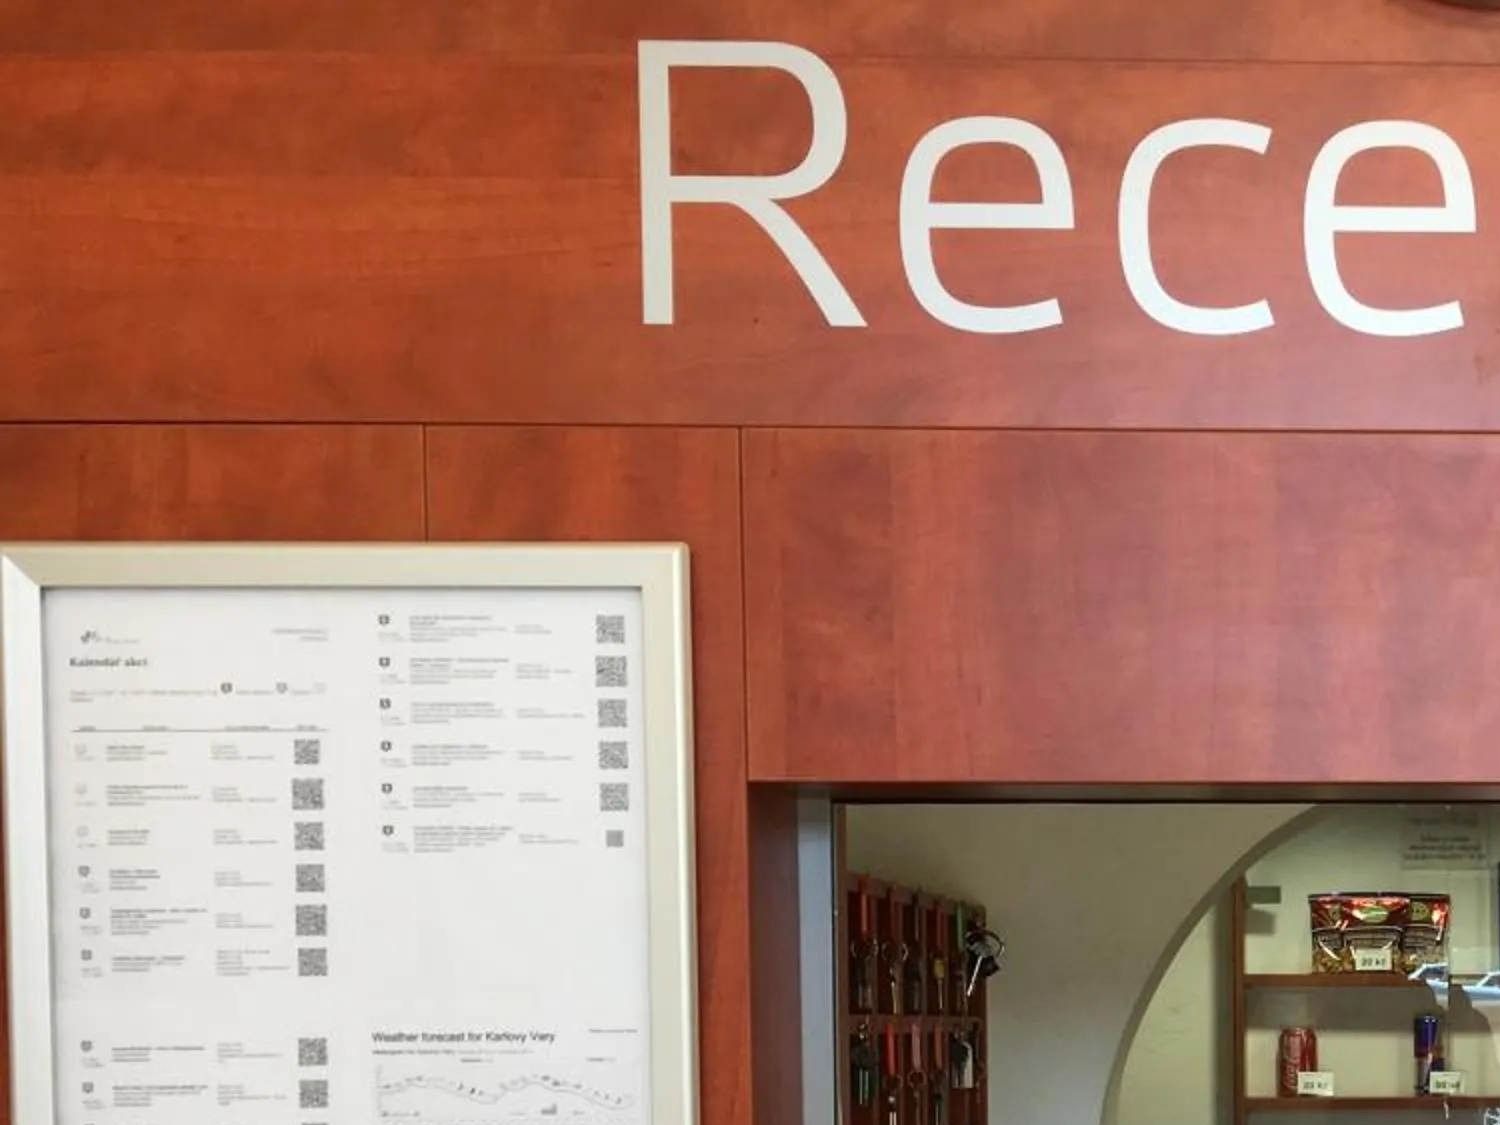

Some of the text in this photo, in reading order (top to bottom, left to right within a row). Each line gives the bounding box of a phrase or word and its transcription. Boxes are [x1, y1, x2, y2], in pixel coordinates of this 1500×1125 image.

[371, 1032, 556, 1044] Weather forecast for Karlovy Vary
